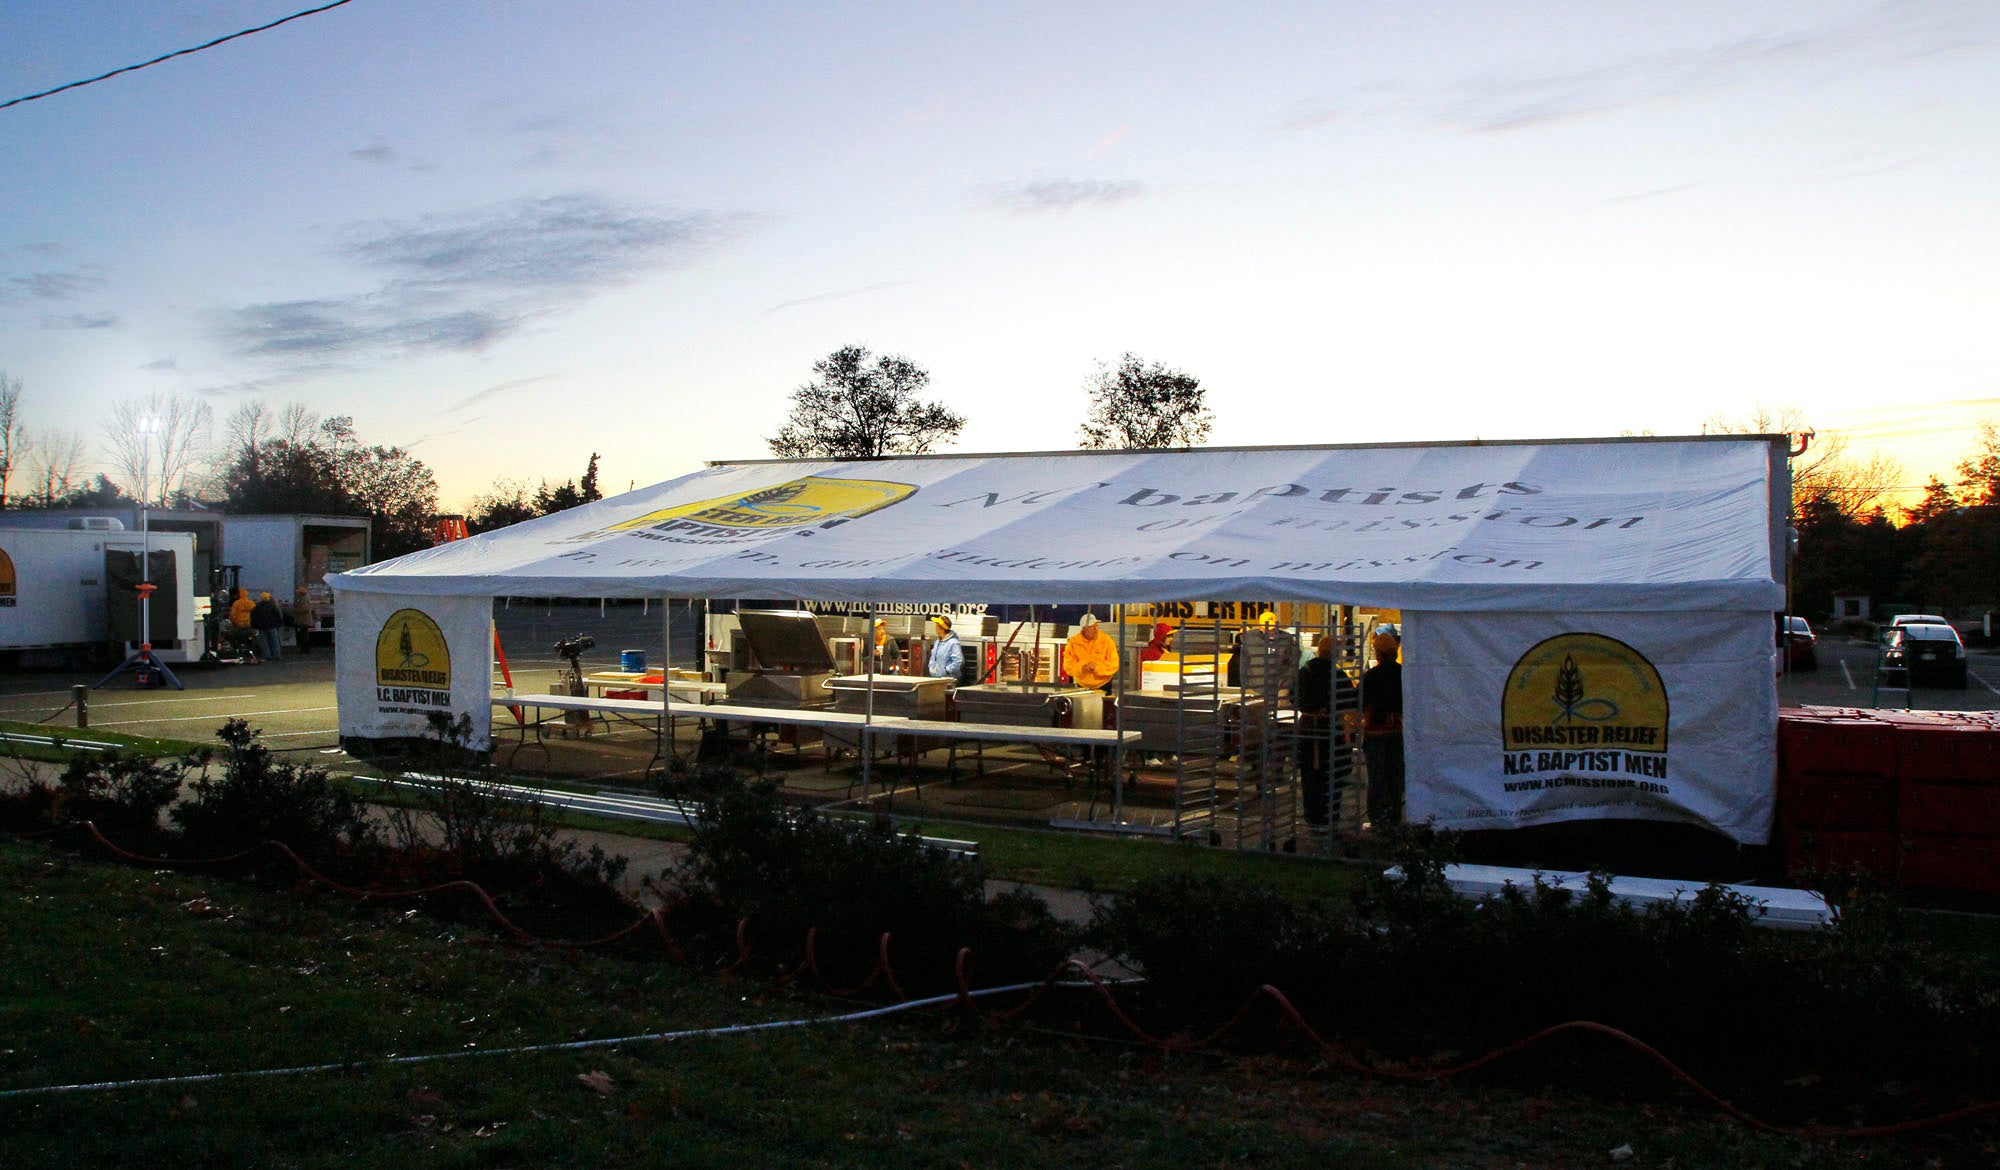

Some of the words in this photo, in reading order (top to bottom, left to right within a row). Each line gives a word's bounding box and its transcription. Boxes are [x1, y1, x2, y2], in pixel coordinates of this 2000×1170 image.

[1117, 481, 1543, 507] baptists
[1266, 507, 1645, 532] mission
[1168, 552, 1250, 567] on
[1268, 547, 1544, 571] mission
[392, 688, 431, 705] BAPTIST
[1511, 726, 1598, 744] DISASTER
[1602, 726, 1659, 745] RELIEF
[1504, 753, 1534, 775] N.C.
[1537, 751, 1621, 772] BAPTIST
[1624, 753, 1667, 779] MEN
[1504, 777, 1669, 794] WWW.NCMISSIONS.ORG
